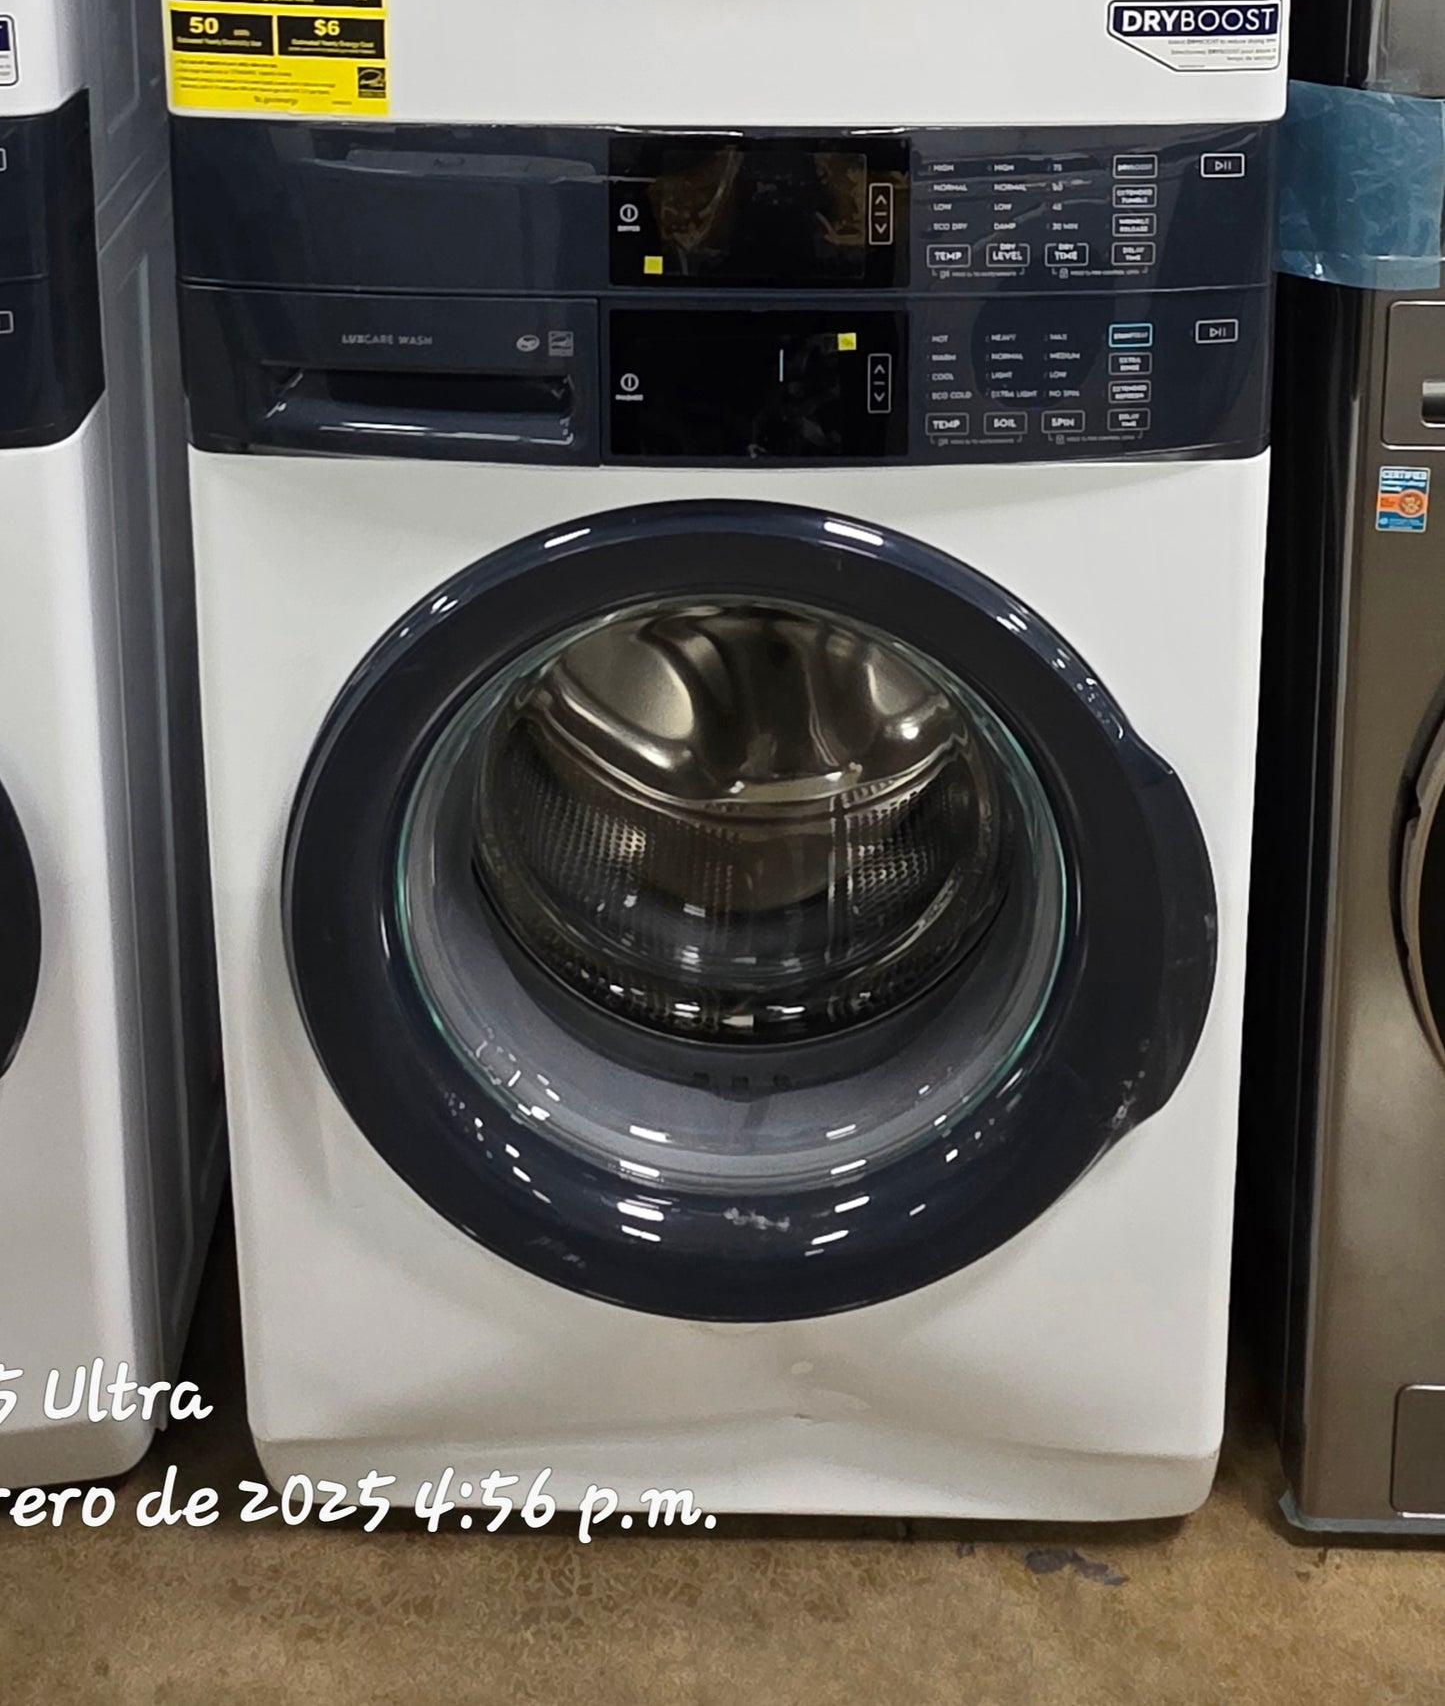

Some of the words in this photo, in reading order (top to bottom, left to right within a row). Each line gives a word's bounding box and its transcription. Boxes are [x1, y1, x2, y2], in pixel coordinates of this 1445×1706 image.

[189, 16, 219, 35] 50
[1122, 8, 1275, 32] DRYBOOST
[313, 19, 341, 37] $6
[933, 183, 968, 192] NORMAL
[933, 203, 953, 211] LOW
[993, 203, 1013, 211] LOW
[934, 251, 962, 262] TEMP
[992, 250, 1024, 261] LEVEL
[1054, 250, 1078, 261] TIME
[341, 333, 394, 345] LUXCARE
[398, 335, 433, 346] WASH
[931, 373, 955, 381] COOL
[1049, 371, 1068, 379] LOW
[932, 419, 961, 430] TEMP
[993, 418, 1017, 429] SOIL
[1051, 417, 1075, 428] SPIN
